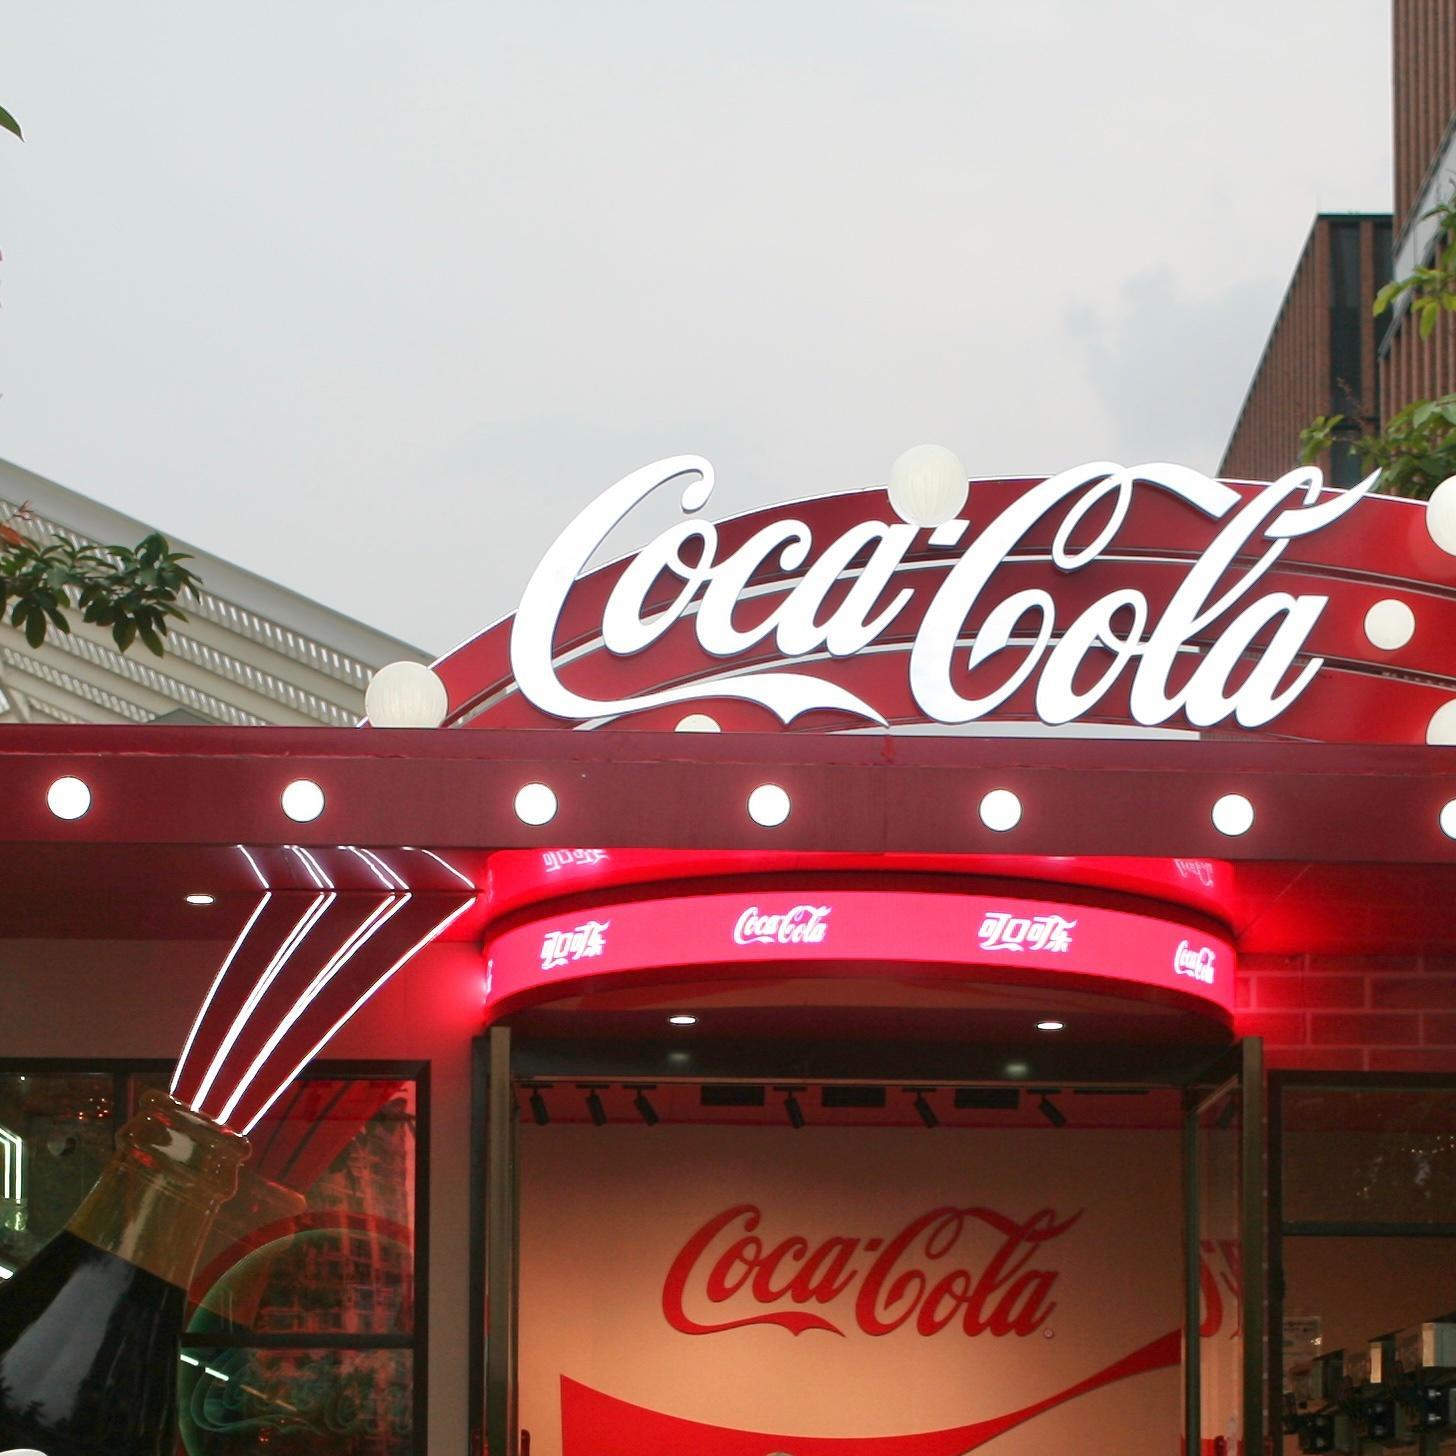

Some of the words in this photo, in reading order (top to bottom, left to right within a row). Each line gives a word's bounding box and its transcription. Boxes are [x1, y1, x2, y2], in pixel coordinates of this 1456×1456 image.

[510, 454, 1381, 729] Coca-Cola
[540, 920, 611, 970] 可口可乐
[733, 905, 833, 947] Coca-Cola
[978, 912, 1078, 952] 可口可乐
[661, 1203, 1085, 1337] Coca-Cola
